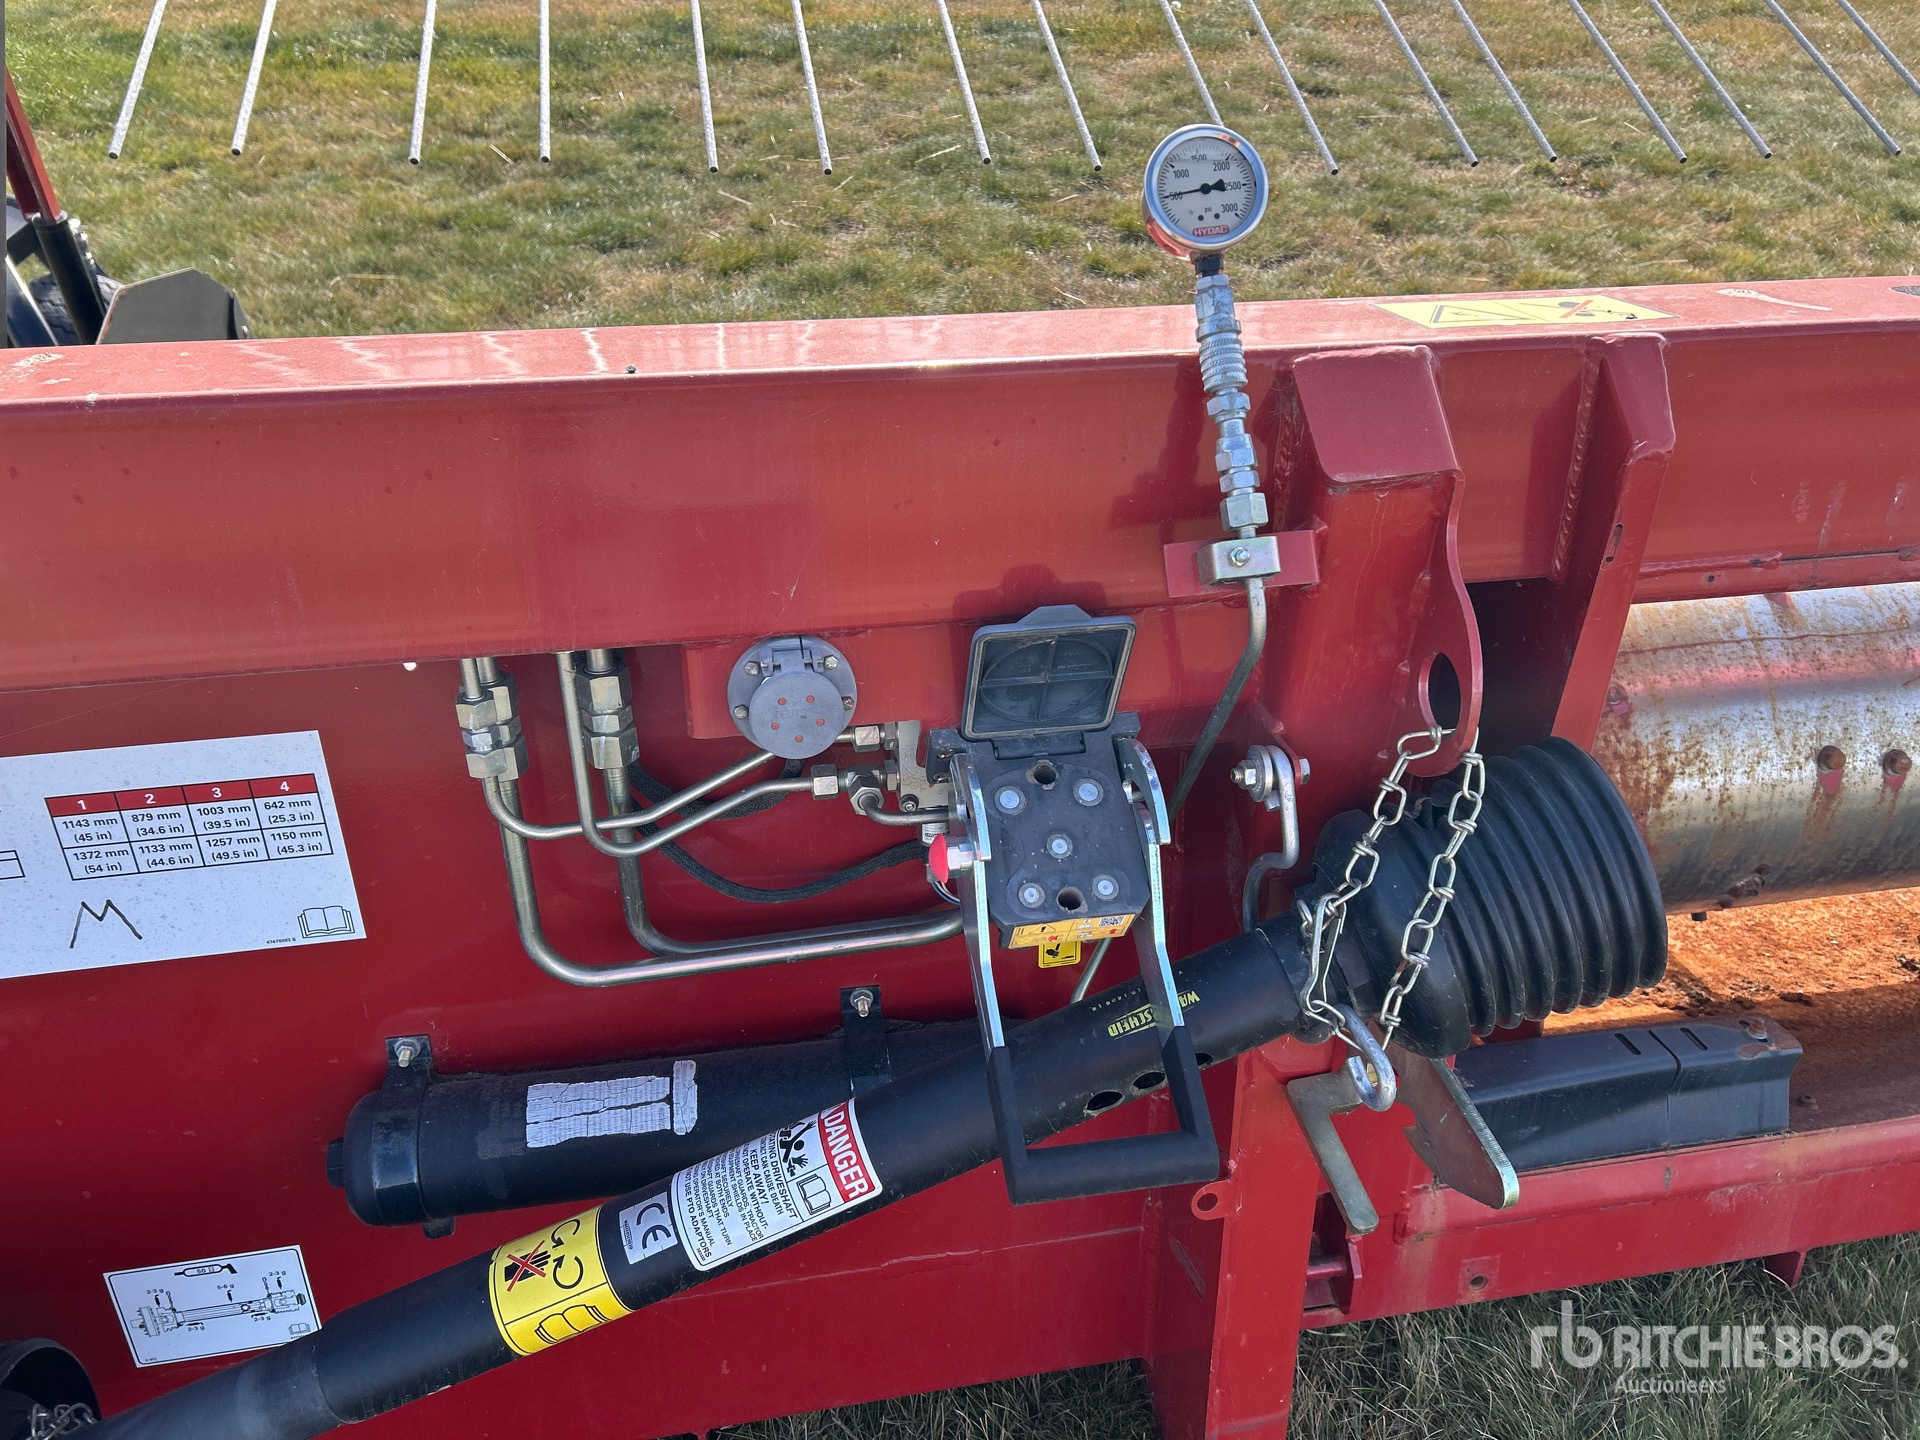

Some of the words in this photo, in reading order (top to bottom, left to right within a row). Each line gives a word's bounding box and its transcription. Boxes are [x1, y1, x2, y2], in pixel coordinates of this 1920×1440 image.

[1191, 154, 1207, 162] 1500
[1213, 162, 1230, 171] 2000
[1173, 169, 1189, 178] 1000
[1224, 181, 1241, 191] 2500
[1169, 191, 1183, 200] 500
[1221, 203, 1238, 213] 3000
[1193, 225, 1228, 236] HYDAC
[78, 800, 86, 810] 1
[145, 794, 156, 804] 2
[212, 788, 222, 798] 3
[280, 782, 289, 791] 4
[197, 807, 224, 816] 1003
[228, 805, 251, 813] mm
[264, 801, 285, 810] 642
[62, 819, 90, 829] 1143
[94, 818, 118, 826] mm
[132, 813, 153, 822] 879
[157, 812, 181, 820] mm
[268, 814, 296, 824] (25.3
[299, 812, 314, 821] in)
[137, 826, 165, 837] (34.6
[169, 824, 184, 834] in)
[204, 820, 232, 831] (39.5
[236, 818, 250, 827] in)
[74, 832, 93, 843] (45
[96, 831, 112, 840] in)
[206, 838, 232, 848] 1257
[237, 836, 260, 844] mm
[271, 832, 296, 841] 1150
[73, 851, 102, 860] 1372
[105, 849, 129, 858] mm
[139, 844, 165, 854] 1133
[170, 843, 193, 851] mm
[212, 851, 240, 861] (49.5
[244, 849, 258, 858] in)
[277, 845, 304, 855] (45.3
[308, 842, 322, 852] in)
[85, 864, 103, 874] (54
[107, 862, 122, 872] in)
[147, 857, 175, 868] (44.6
[179, 855, 194, 864] in)
[1107, 990, 1200, 1037] WASCHEID
[750, 1147, 760, 1170] KEEP
[824, 1110, 869, 1199] DANGER
[701, 1169, 706, 1179] ON
[720, 1174, 734, 1207] SECURELY
[742, 1157, 754, 1191] OPERATE
[748, 1191, 769, 1230] WITHOUT-
[752, 1171, 769, 1204] AWAY!
[762, 1169, 774, 1192] CAUSE
[770, 1192, 784, 1215] DEATH
[770, 1159, 798, 1217] DRIVESHAFT
[700, 1178, 714, 1217] DRIVESHAFT
[715, 1178, 723, 1197] BOTH
[719, 1198, 729, 1217] ENDS
[731, 1182, 745, 1212] SHIELDS
[686, 1196, 695, 1213] PTO
[737, 1178, 750, 1209] GUARDS,
[745, 1208, 763, 1239] TRACTOR
[693, 1177, 704, 1217] OPERATOR'S
[700, 1216, 715, 1247] MANUAL
[707, 1180, 718, 1208] GUARDS
[713, 1207, 724, 1225] THAT
[719, 1226, 732, 1246] TURN
[740, 1212, 747, 1220] IN
[637, 1201, 672, 1250] CE
[743, 1221, 757, 1242] PLACE
[689, 1214, 712, 1257] ADAPTORS
